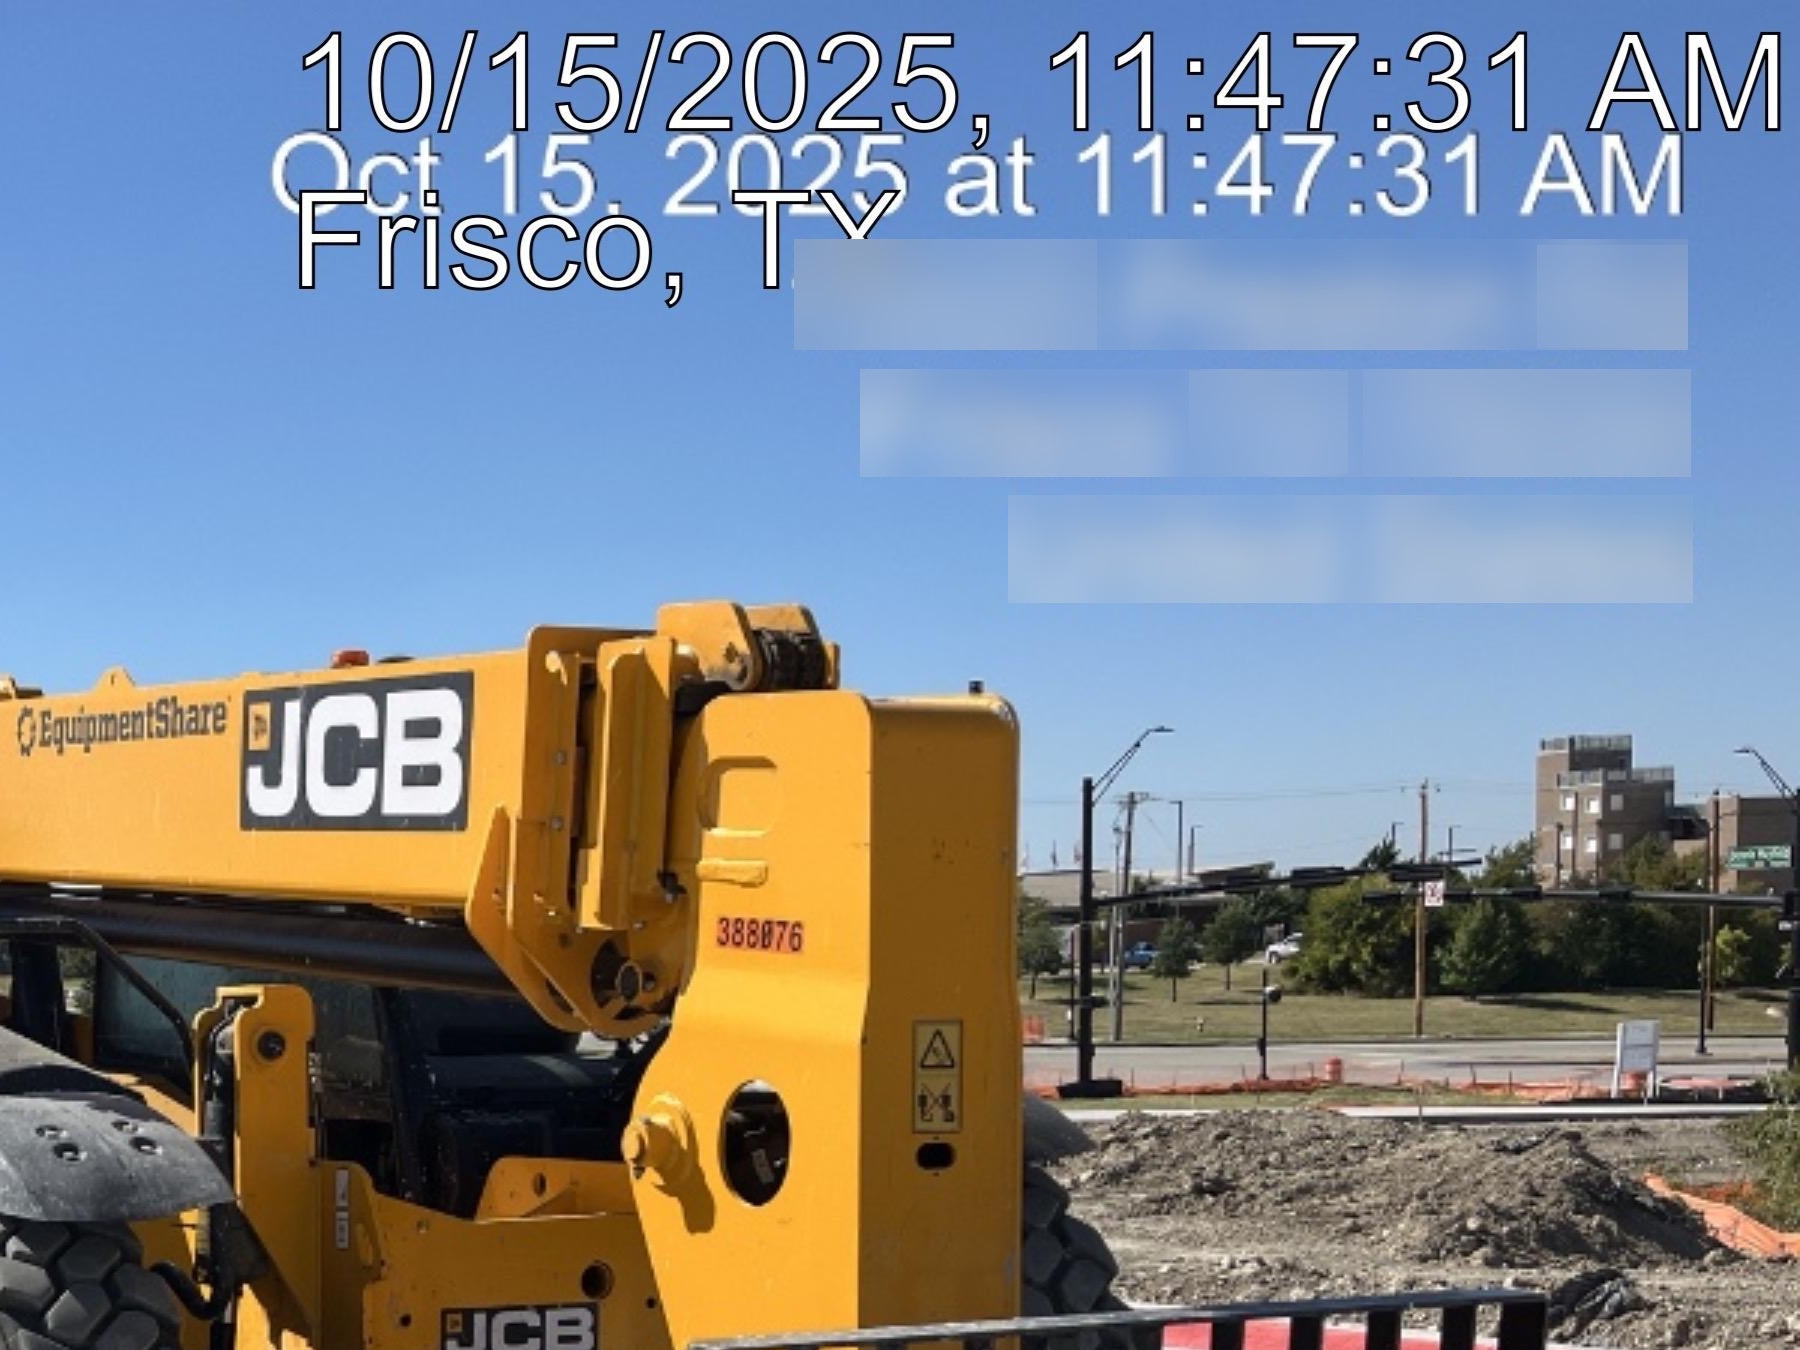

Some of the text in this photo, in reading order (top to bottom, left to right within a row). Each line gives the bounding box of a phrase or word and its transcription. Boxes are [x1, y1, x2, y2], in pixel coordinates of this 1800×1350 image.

[39, 696, 227, 755] EquipmentShare
[246, 688, 464, 818] JCB
[717, 917, 804, 952] 388076
